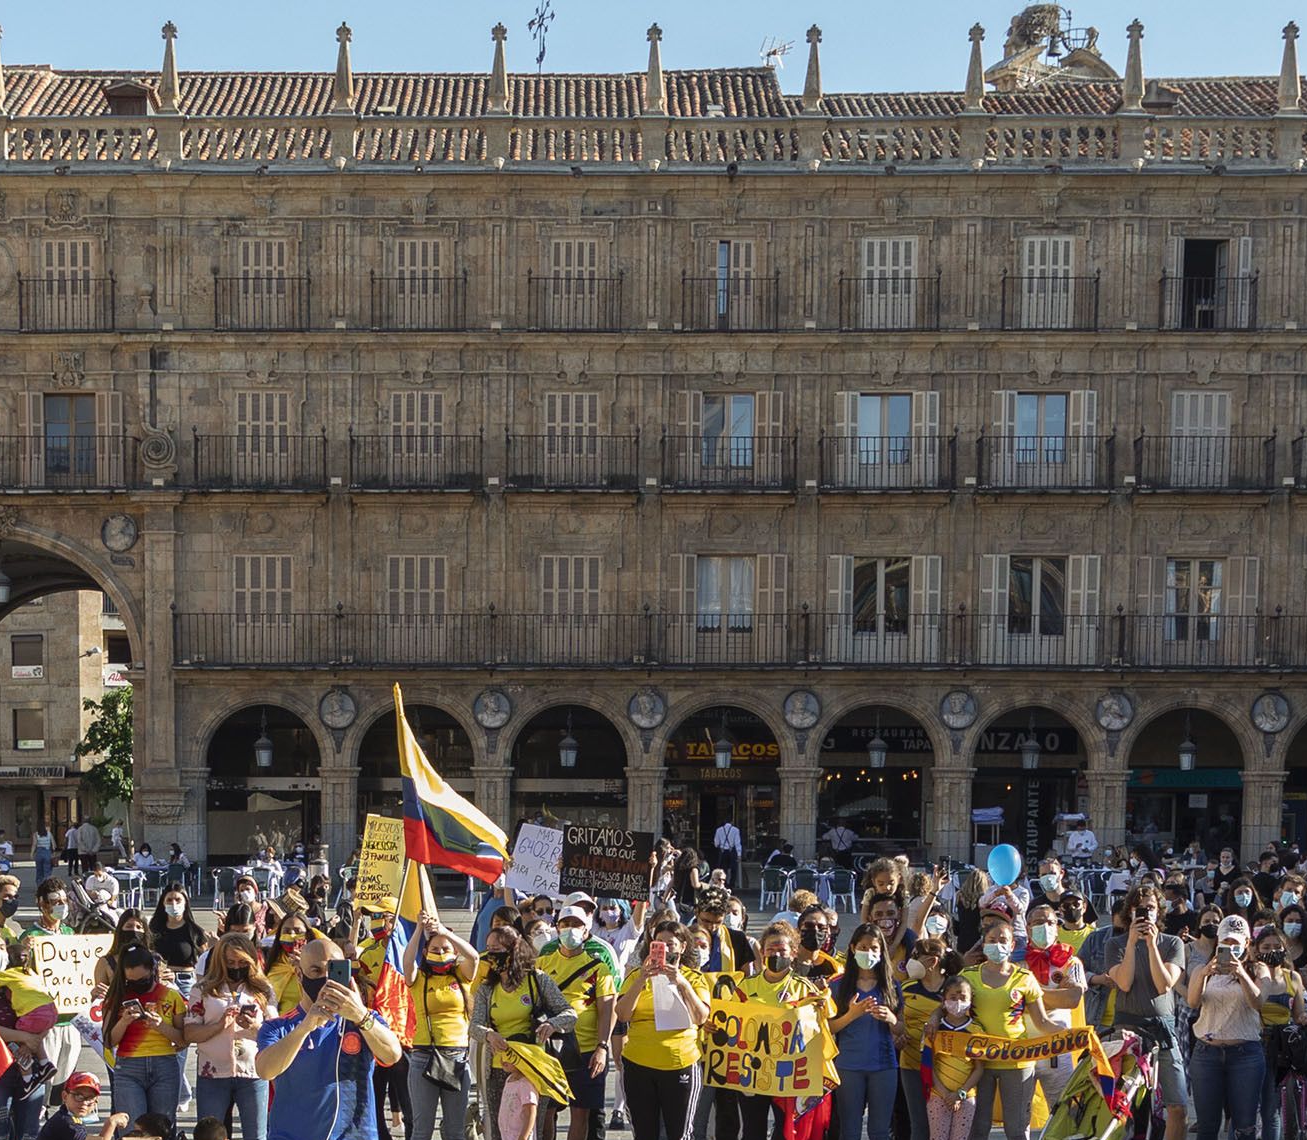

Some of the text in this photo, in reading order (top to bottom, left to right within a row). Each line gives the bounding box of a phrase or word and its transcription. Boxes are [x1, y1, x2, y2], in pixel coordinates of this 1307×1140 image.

[686, 742, 780, 757] TAACOS
[700, 768, 742, 779] TABACOS
[518, 836, 551, 860] 6402
[567, 826, 634, 848] GRITAMOS
[589, 846, 603, 856] POR
[619, 849, 637, 861] QUE
[42, 942, 103, 971] Duque
[965, 1030, 1089, 1061] Colombia
